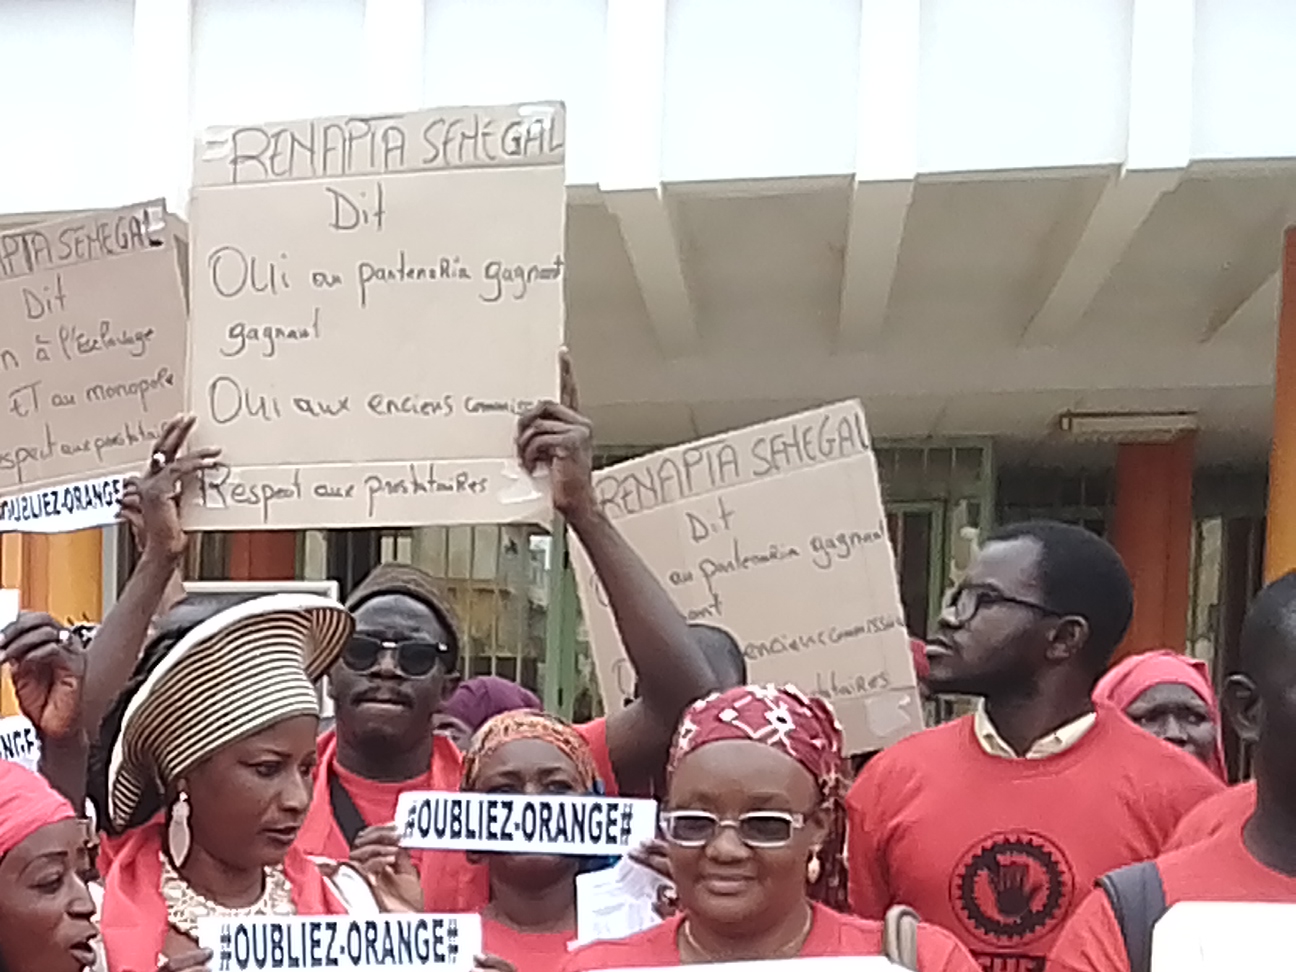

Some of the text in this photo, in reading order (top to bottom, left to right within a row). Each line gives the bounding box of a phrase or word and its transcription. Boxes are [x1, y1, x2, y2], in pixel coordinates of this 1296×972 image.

[229, 115, 404, 184] RENAPTA
[325, 183, 385, 231] Dit
[22, 273, 67, 319] Dit
[51, 393, 76, 407] au
[293, 396, 351, 417] aux
[685, 495, 736, 543] Dit
[404, 797, 634, 846] #OUBLIEZ-ORANGE#
[218, 917, 460, 971] #OUBLIEZ-ORANGE#
